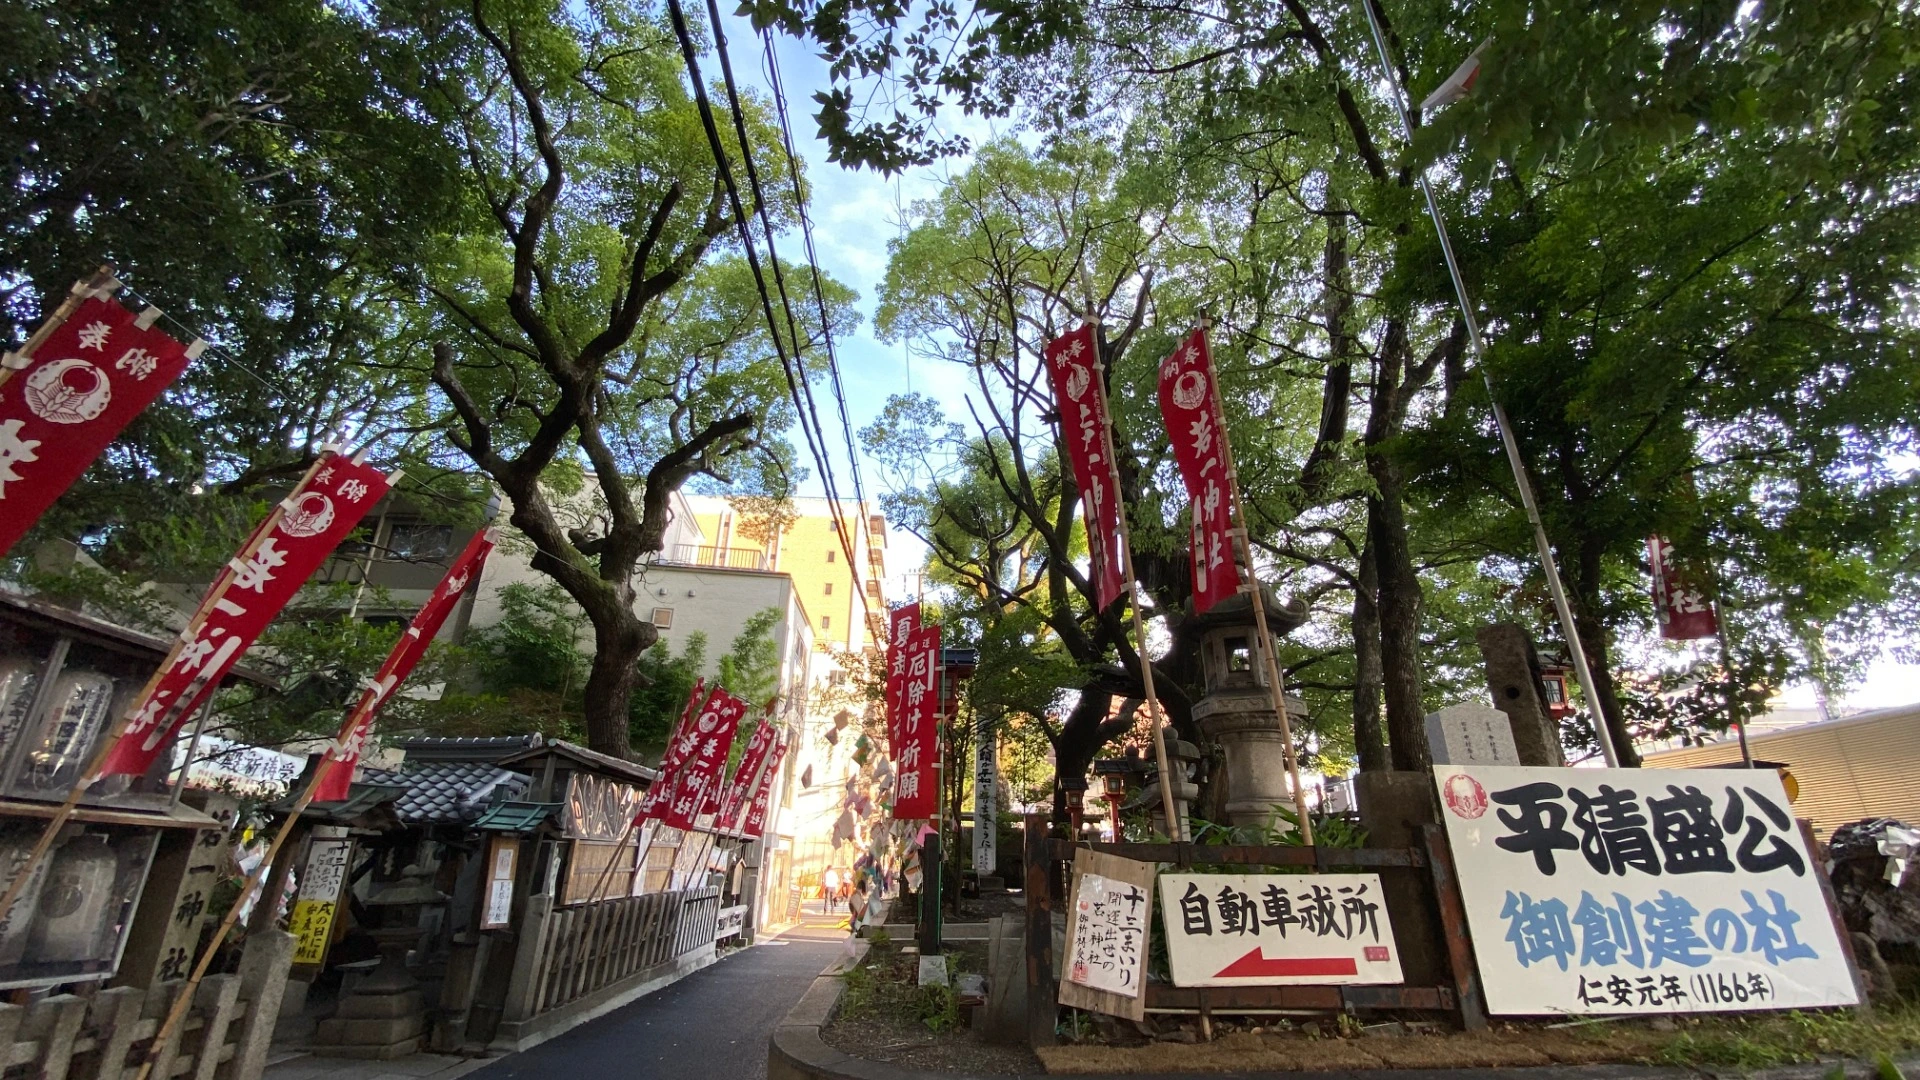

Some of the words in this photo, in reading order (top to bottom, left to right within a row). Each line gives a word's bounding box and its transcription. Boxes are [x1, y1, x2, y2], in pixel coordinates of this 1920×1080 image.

[1164, 346, 1200, 381] 奉納
[899, 652, 926, 799] 厄除け祈願
[1491, 781, 1805, 877] 平清盛公
[157, 809, 230, 983] 若一神社
[307, 901, 334, 959] 戌の日には
[1087, 901, 1106, 966] 若一神社
[1103, 891, 1121, 972] 開運出世の
[1119, 885, 1145, 987] 十三まいり
[1180, 881, 1379, 943] 自動車祓所
[1500, 889, 1819, 972] 御創建の社
